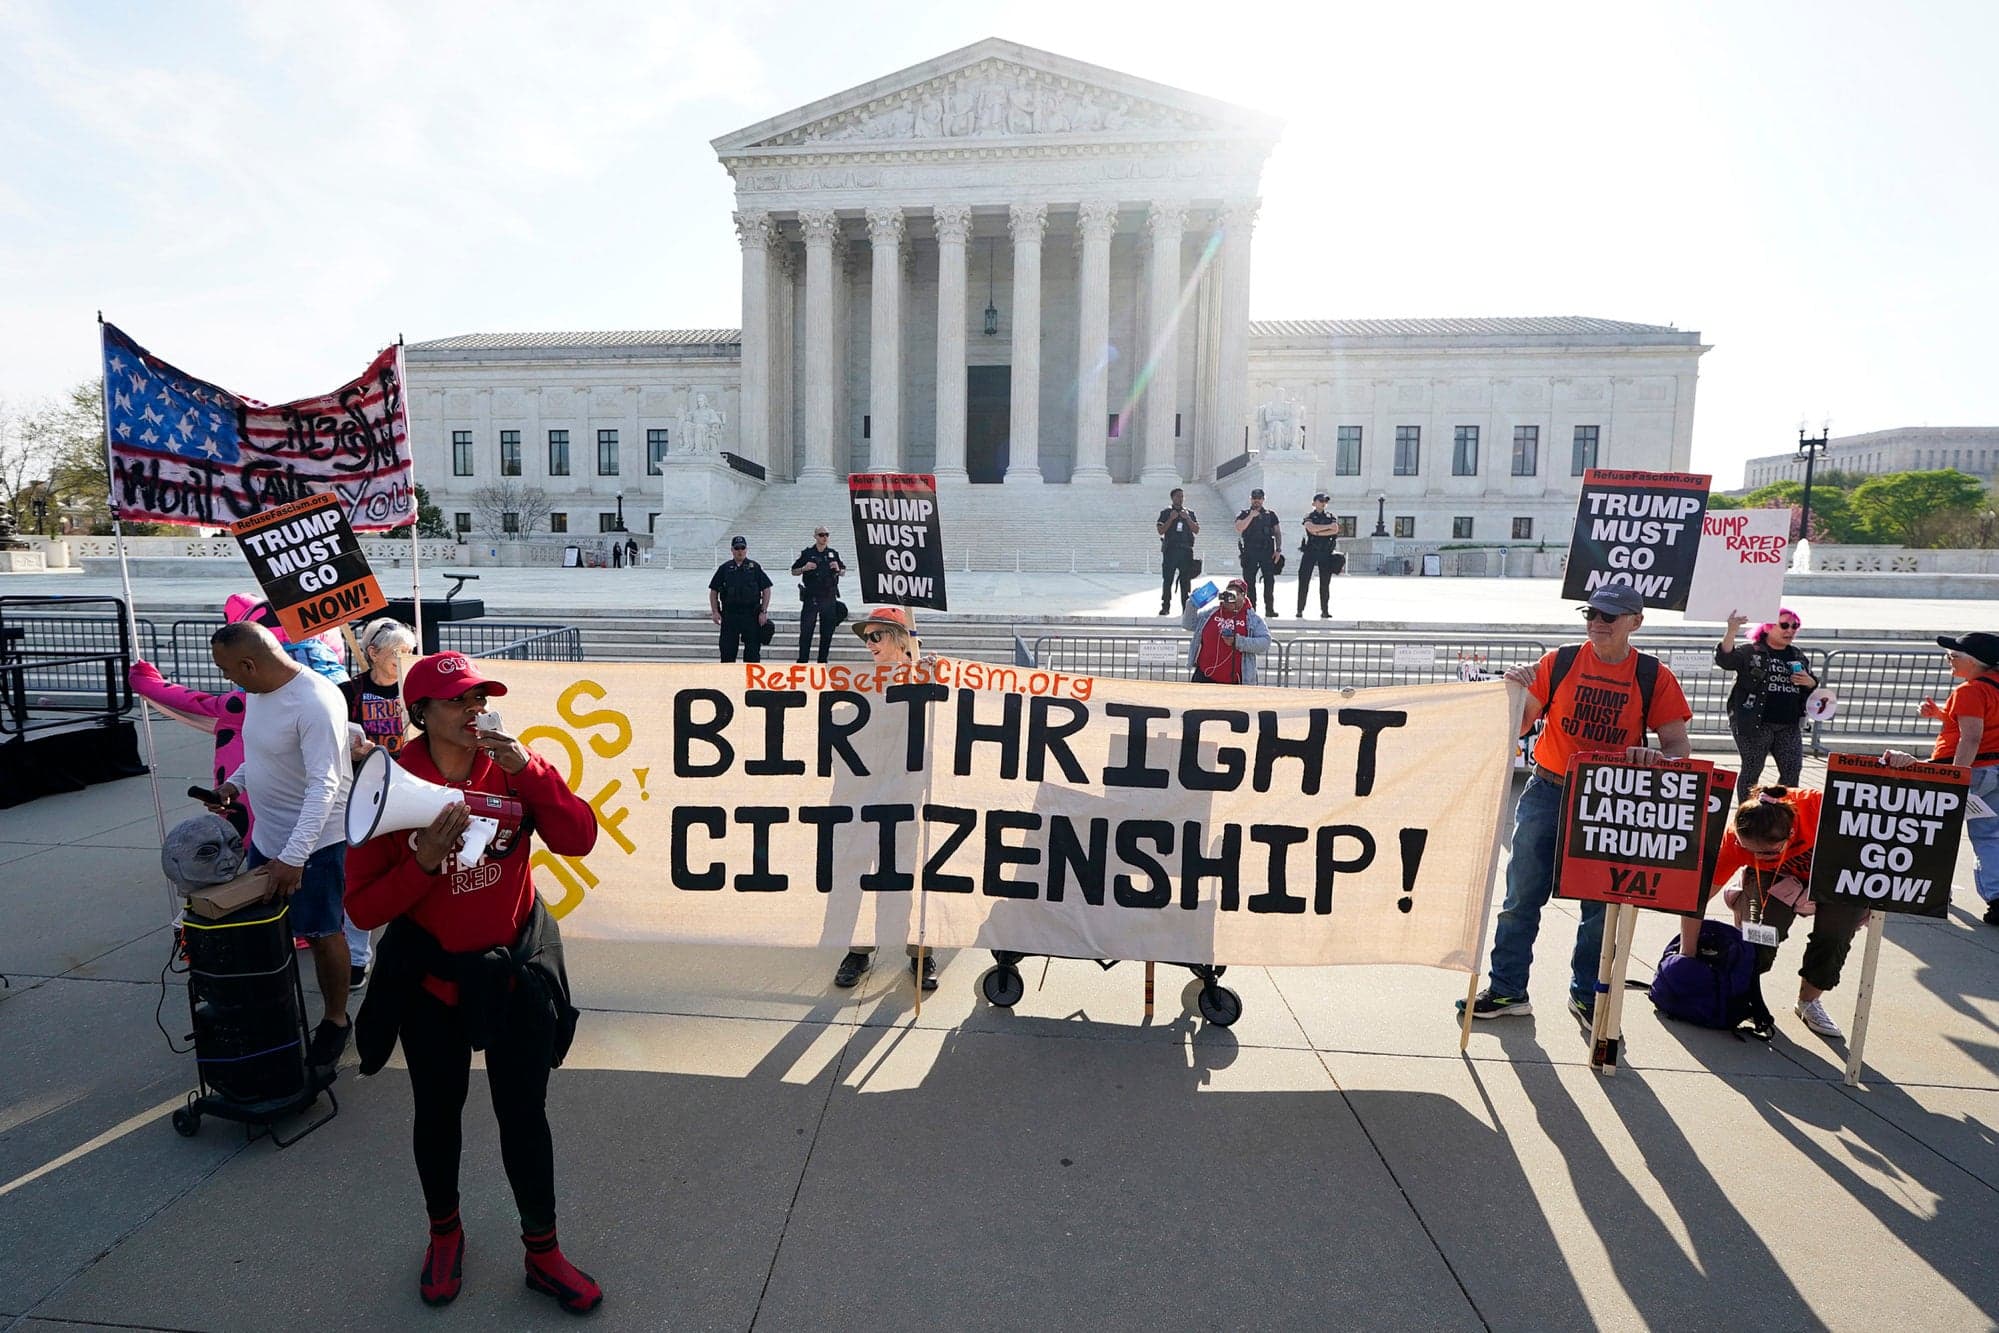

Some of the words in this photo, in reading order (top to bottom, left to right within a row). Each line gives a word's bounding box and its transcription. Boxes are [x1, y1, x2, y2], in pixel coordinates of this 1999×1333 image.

[1592, 471, 1703, 485] RefuseFascism.org
[236, 494, 329, 531] RefuseFascism.org
[854, 498, 933, 522] TRUMP
[1587, 492, 1701, 520] TRUMP
[244, 509, 341, 557] TRUMP
[866, 523, 928, 548] MUST
[1590, 519, 1685, 546] MUST
[1703, 514, 1749, 537] RUMP
[266, 534, 342, 578] MUST
[1726, 535, 1787, 550] RAPED
[1740, 550, 1782, 564] KIDS
[885, 549, 917, 573] GO
[1607, 546, 1655, 570] GO
[299, 564, 338, 593] GO
[878, 573, 933, 598] NOW!
[1584, 570, 1674, 599] NOW!
[297, 583, 370, 629] NOW!
[1574, 684, 1630, 709] TRUMP
[1574, 702, 1623, 726] MUST
[673, 684, 1408, 796] BIRTHRIGHT
[1561, 717, 1580, 736] GO
[1581, 722, 1629, 745] NOW!
[1584, 766, 1652, 797] ¡QUE
[1660, 771, 1698, 801] SE
[1833, 780, 1960, 817] TRUMP
[1578, 796, 1695, 831] LARGUE
[1838, 810, 1944, 846] MUST
[1582, 826, 1687, 861] TRUMP
[1860, 842, 1914, 873] GO
[670, 803, 1428, 915] CITIZENSHIP!
[451, 863, 502, 895] RED
[1609, 867, 1662, 896] YA!
[1834, 868, 1933, 904] NOW!
